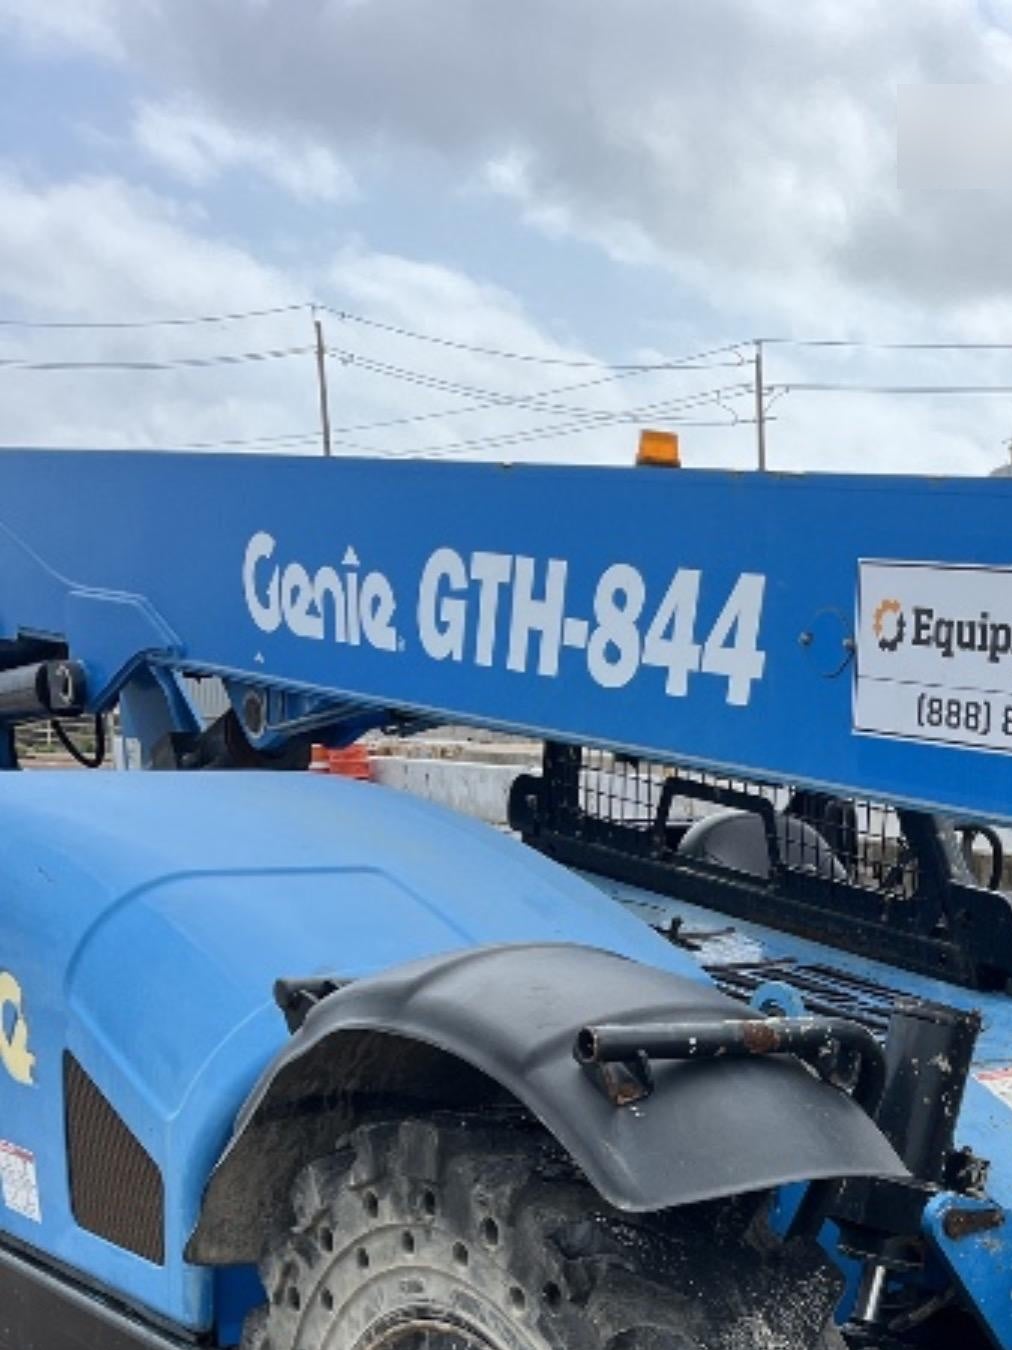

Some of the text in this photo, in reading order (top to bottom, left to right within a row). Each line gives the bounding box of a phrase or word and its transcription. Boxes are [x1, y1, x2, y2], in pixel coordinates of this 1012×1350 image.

[242, 530, 767, 706] Genie GTH-844
[916, 692, 991, 736] (888)
